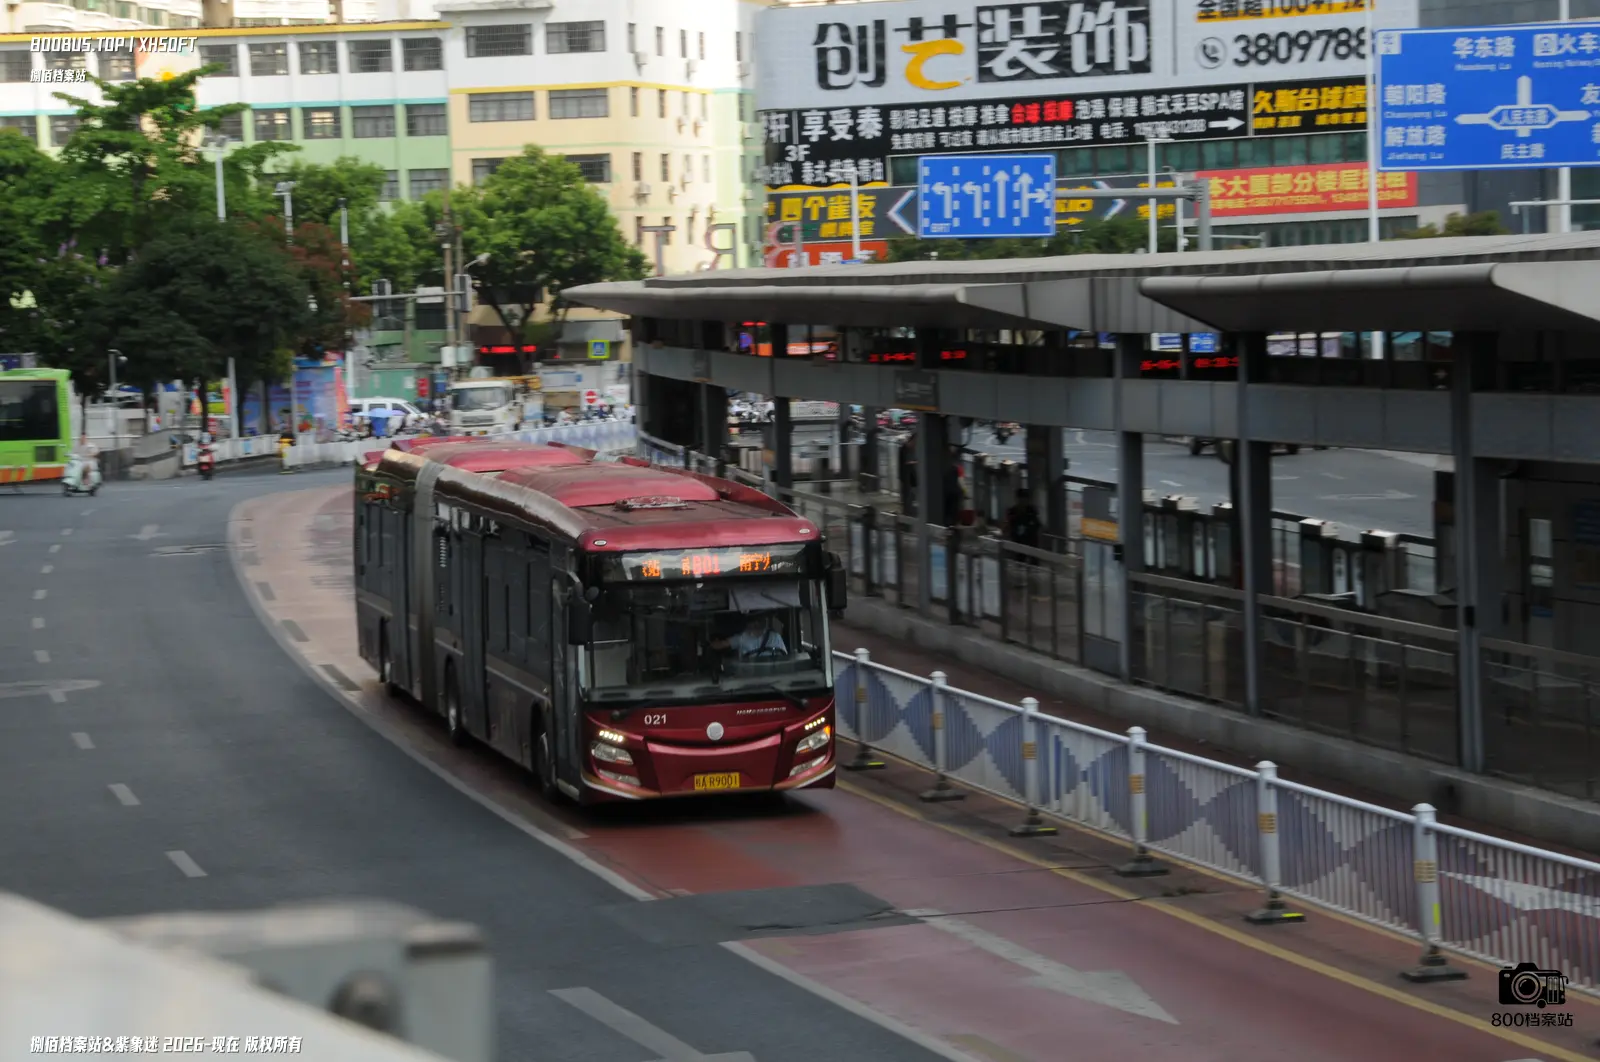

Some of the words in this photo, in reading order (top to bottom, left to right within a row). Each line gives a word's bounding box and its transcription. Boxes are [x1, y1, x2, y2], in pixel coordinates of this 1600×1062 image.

[812, 0, 1150, 92] 创艺装饰
[1453, 35, 1516, 59] 华东路
[1384, 83, 1448, 106] 朝阳路
[1499, 108, 1549, 126] 人民东路
[1384, 125, 1448, 148] 解放路
[785, 144, 811, 162] 3F
[1500, 142, 1546, 160] 民主路
[644, 713, 667, 725] 021
